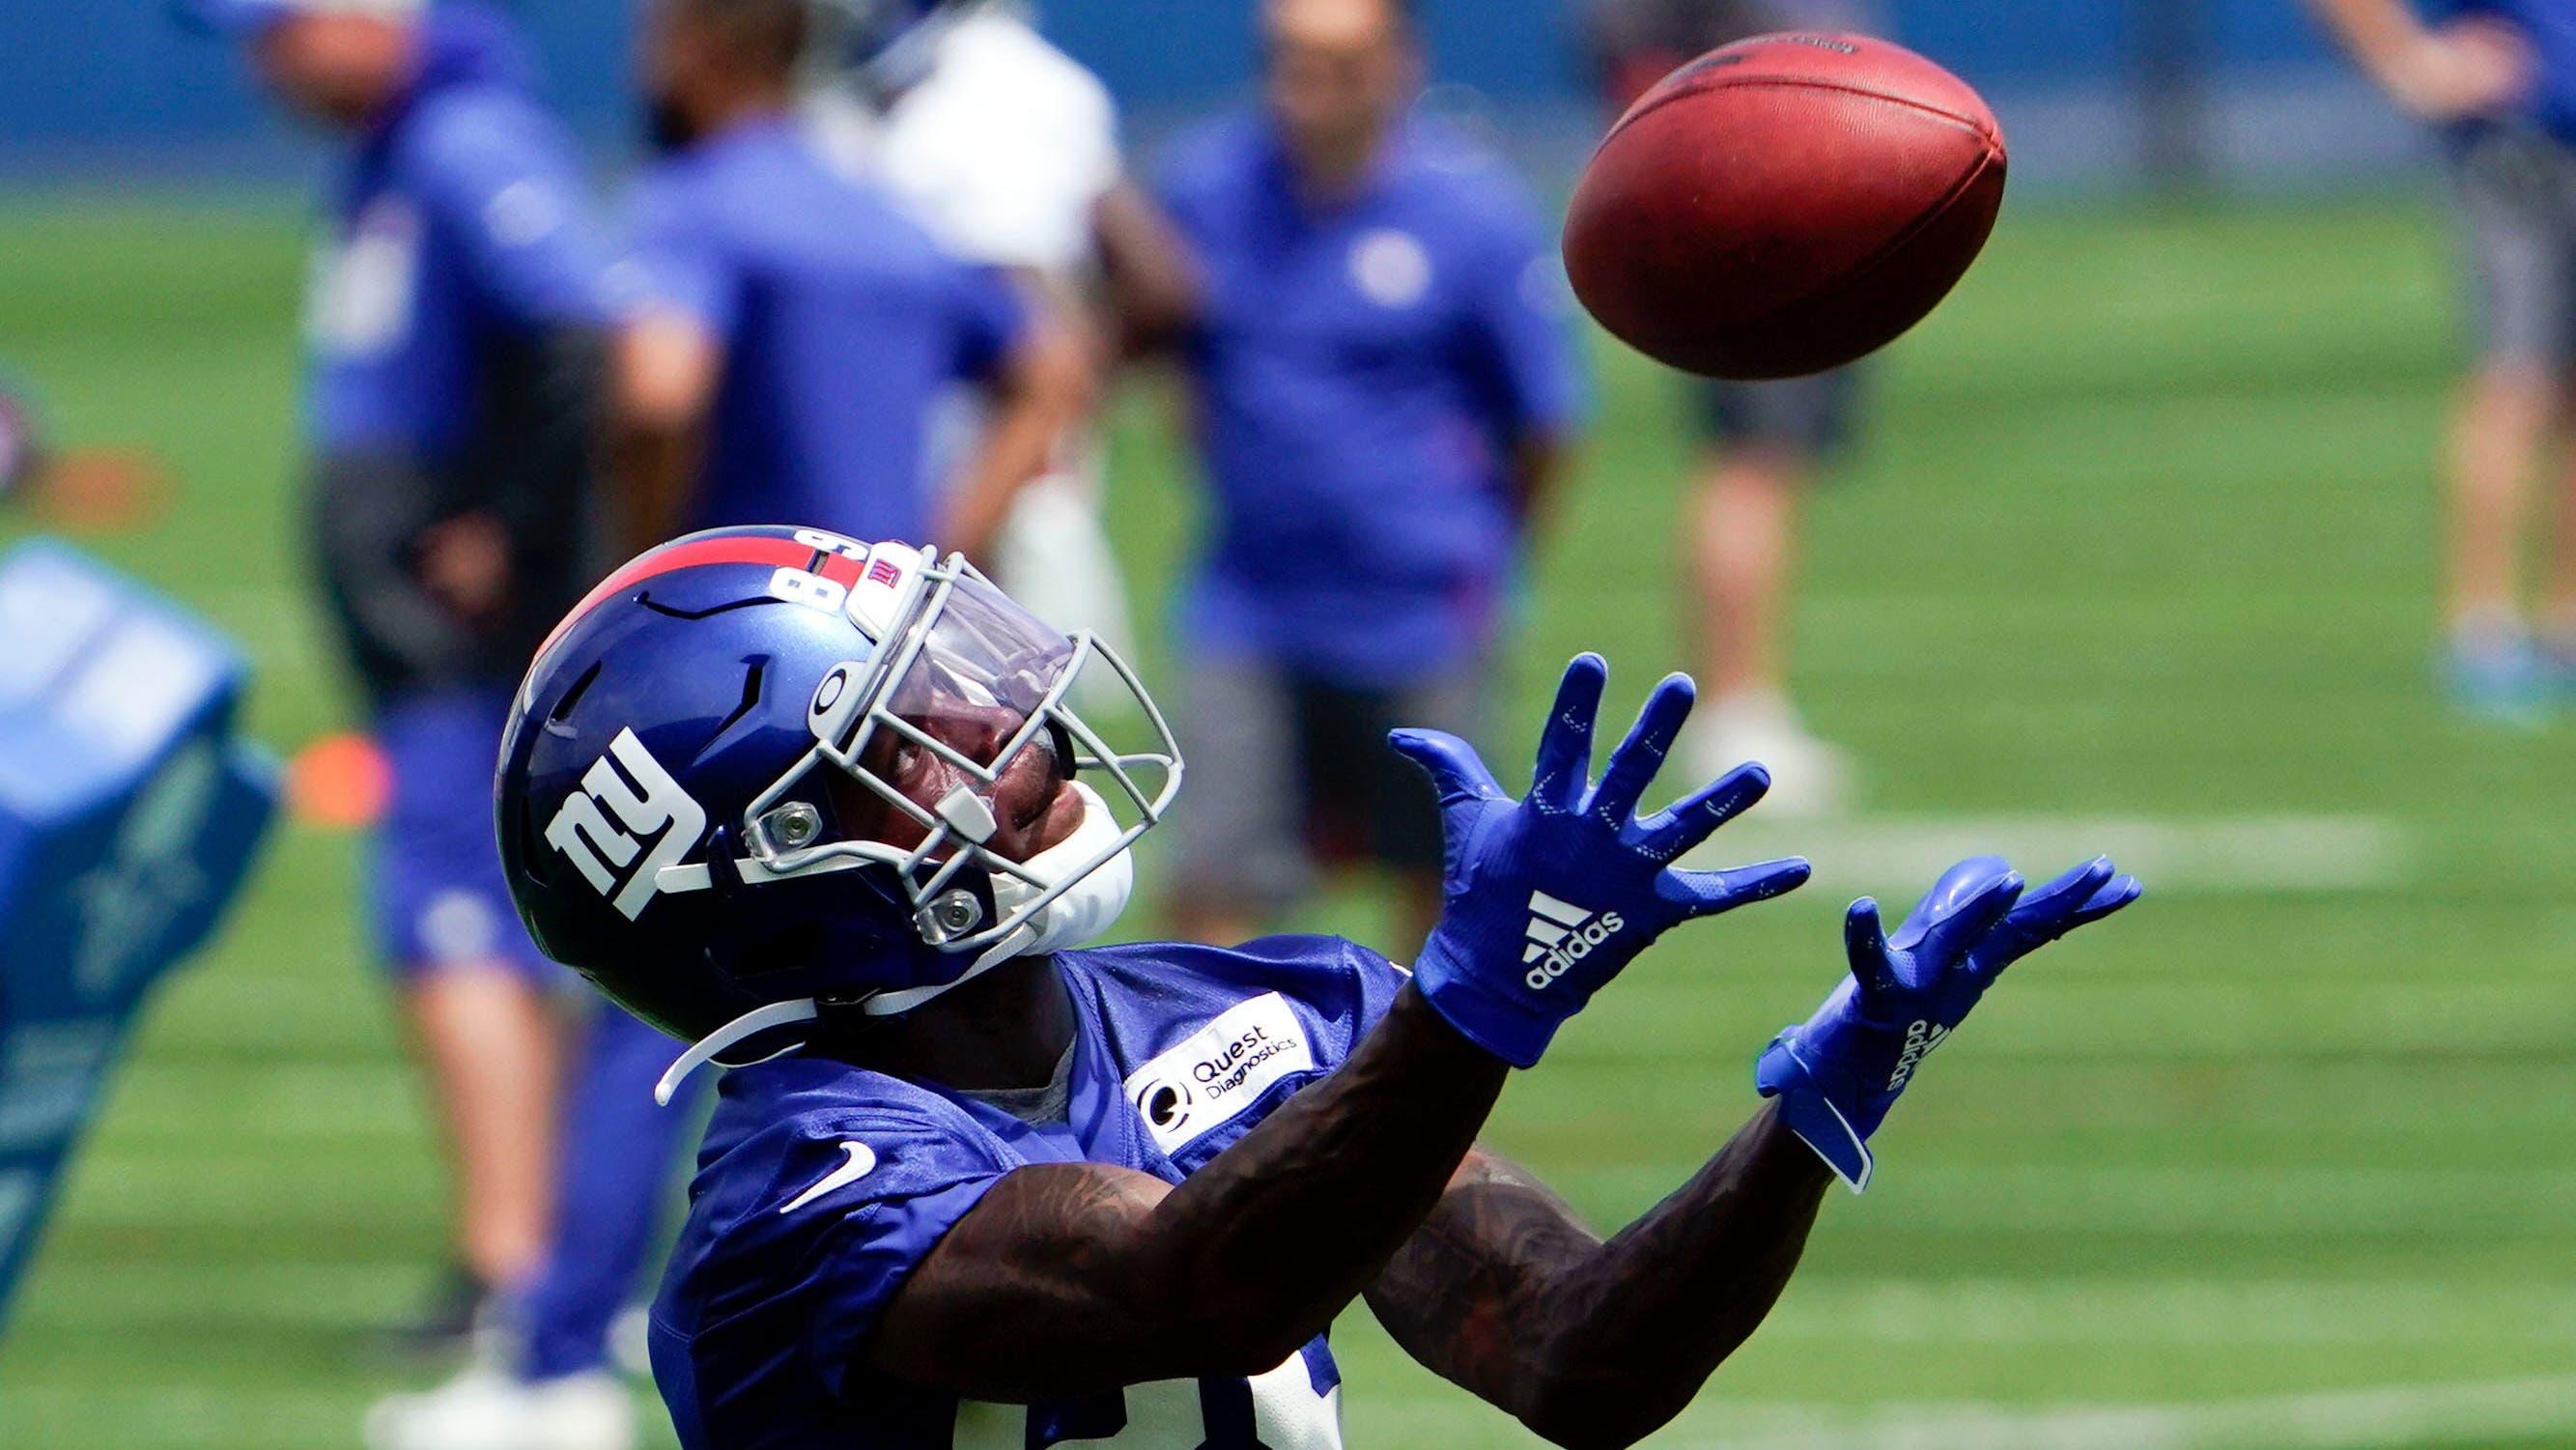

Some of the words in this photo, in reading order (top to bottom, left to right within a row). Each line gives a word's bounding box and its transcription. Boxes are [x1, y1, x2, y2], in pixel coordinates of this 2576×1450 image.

[1526, 911, 1625, 989] adidas
[1193, 1025, 1268, 1083] Quest
[1205, 1038, 1297, 1099] Diagnostics
[1886, 1019, 1929, 1092] adidas
